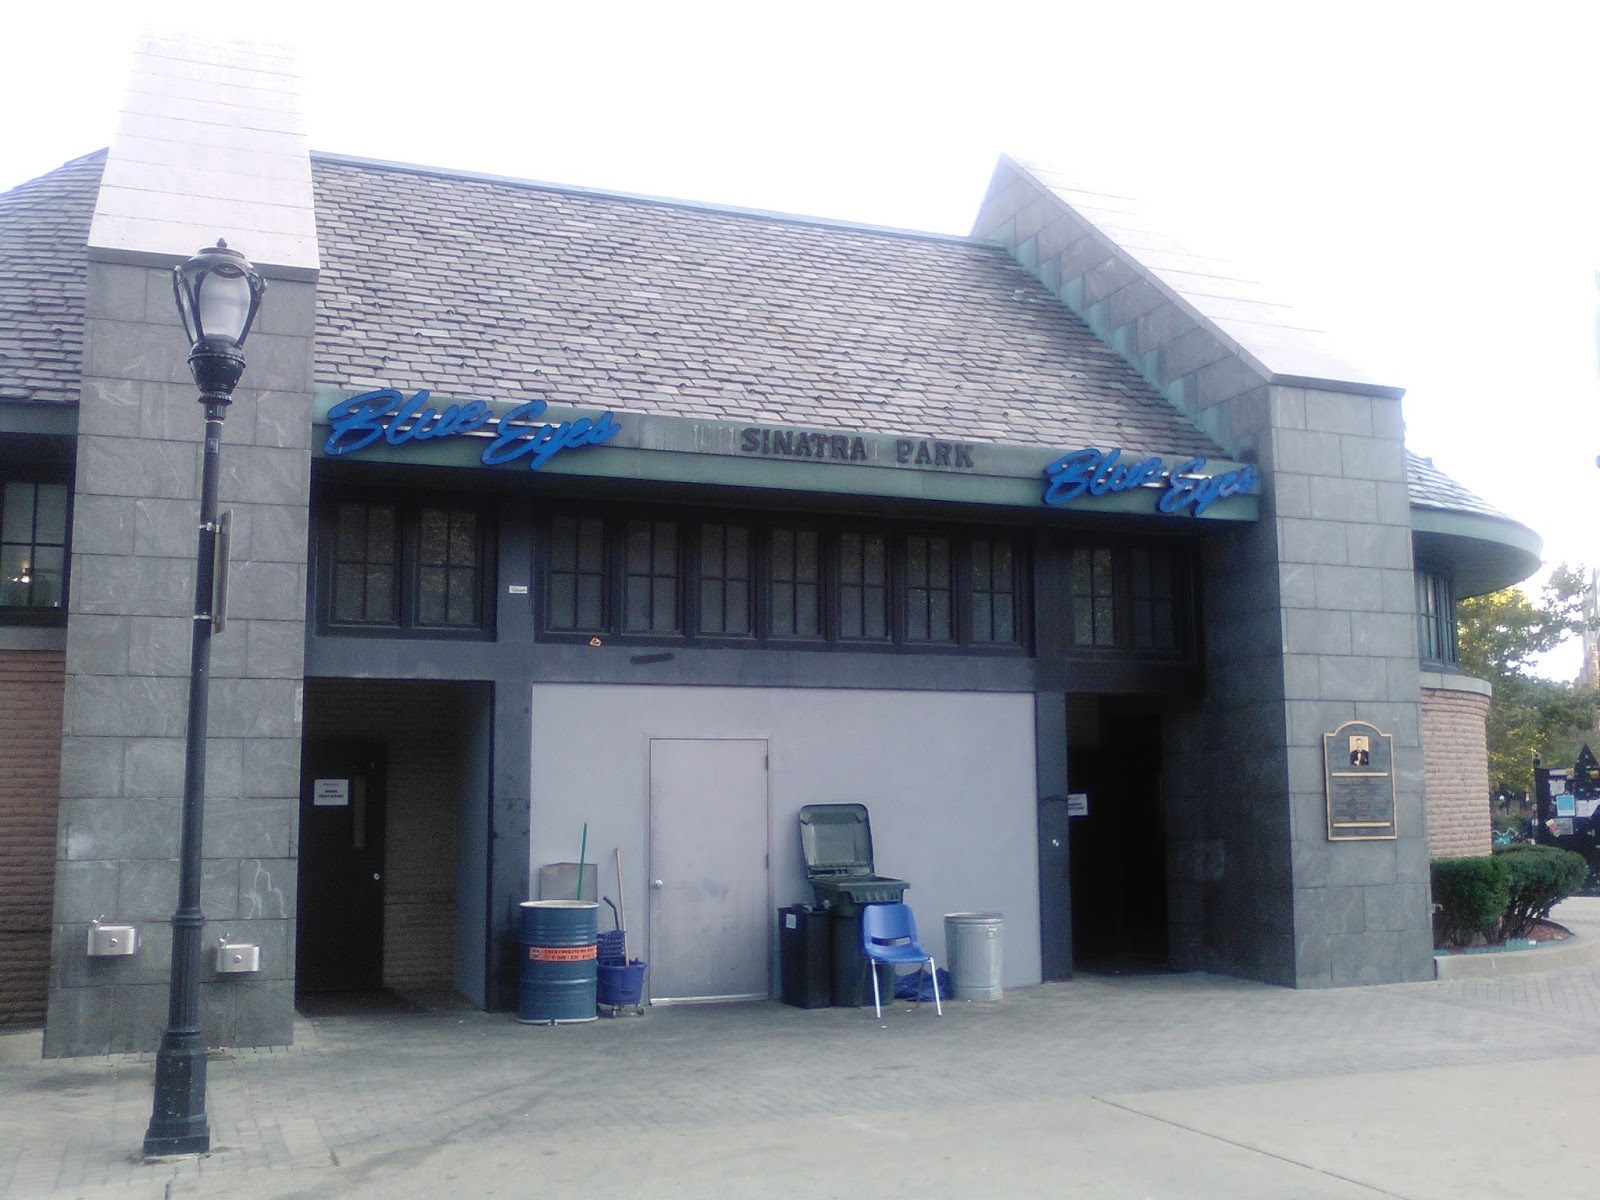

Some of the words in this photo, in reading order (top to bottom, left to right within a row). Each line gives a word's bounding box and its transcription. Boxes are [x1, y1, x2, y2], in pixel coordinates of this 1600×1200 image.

[323, 388, 493, 456] Blue
[480, 399, 622, 471] Eyes
[740, 427, 867, 461] SINATRA
[896, 439, 974, 468] PARK
[1044, 447, 1167, 505] Blue
[1159, 456, 1259, 518] Eyes
